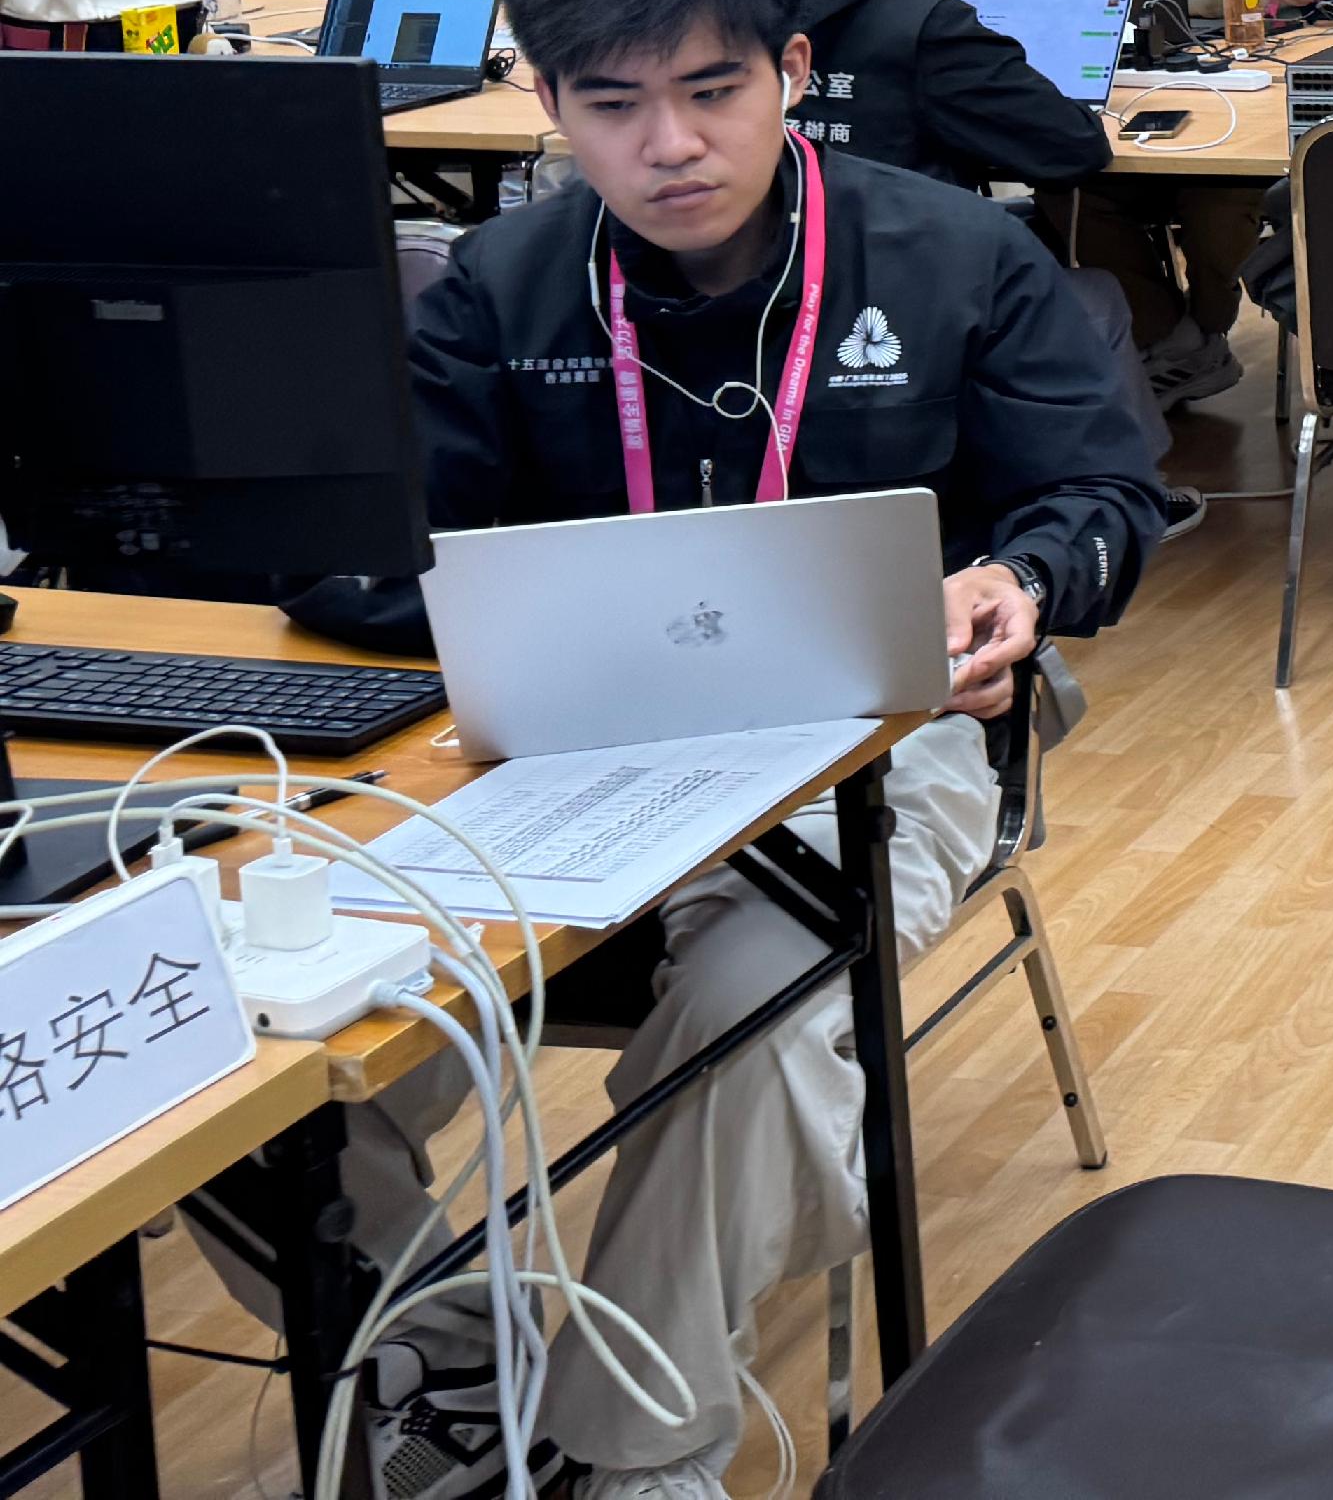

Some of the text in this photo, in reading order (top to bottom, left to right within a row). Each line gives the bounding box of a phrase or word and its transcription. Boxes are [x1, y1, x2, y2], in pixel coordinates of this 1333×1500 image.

[804, 283, 820, 311] Play
[803, 312, 817, 333] for
[797, 334, 812, 356] the
[786, 358, 806, 406] Dreams
[782, 407, 796, 421] in
